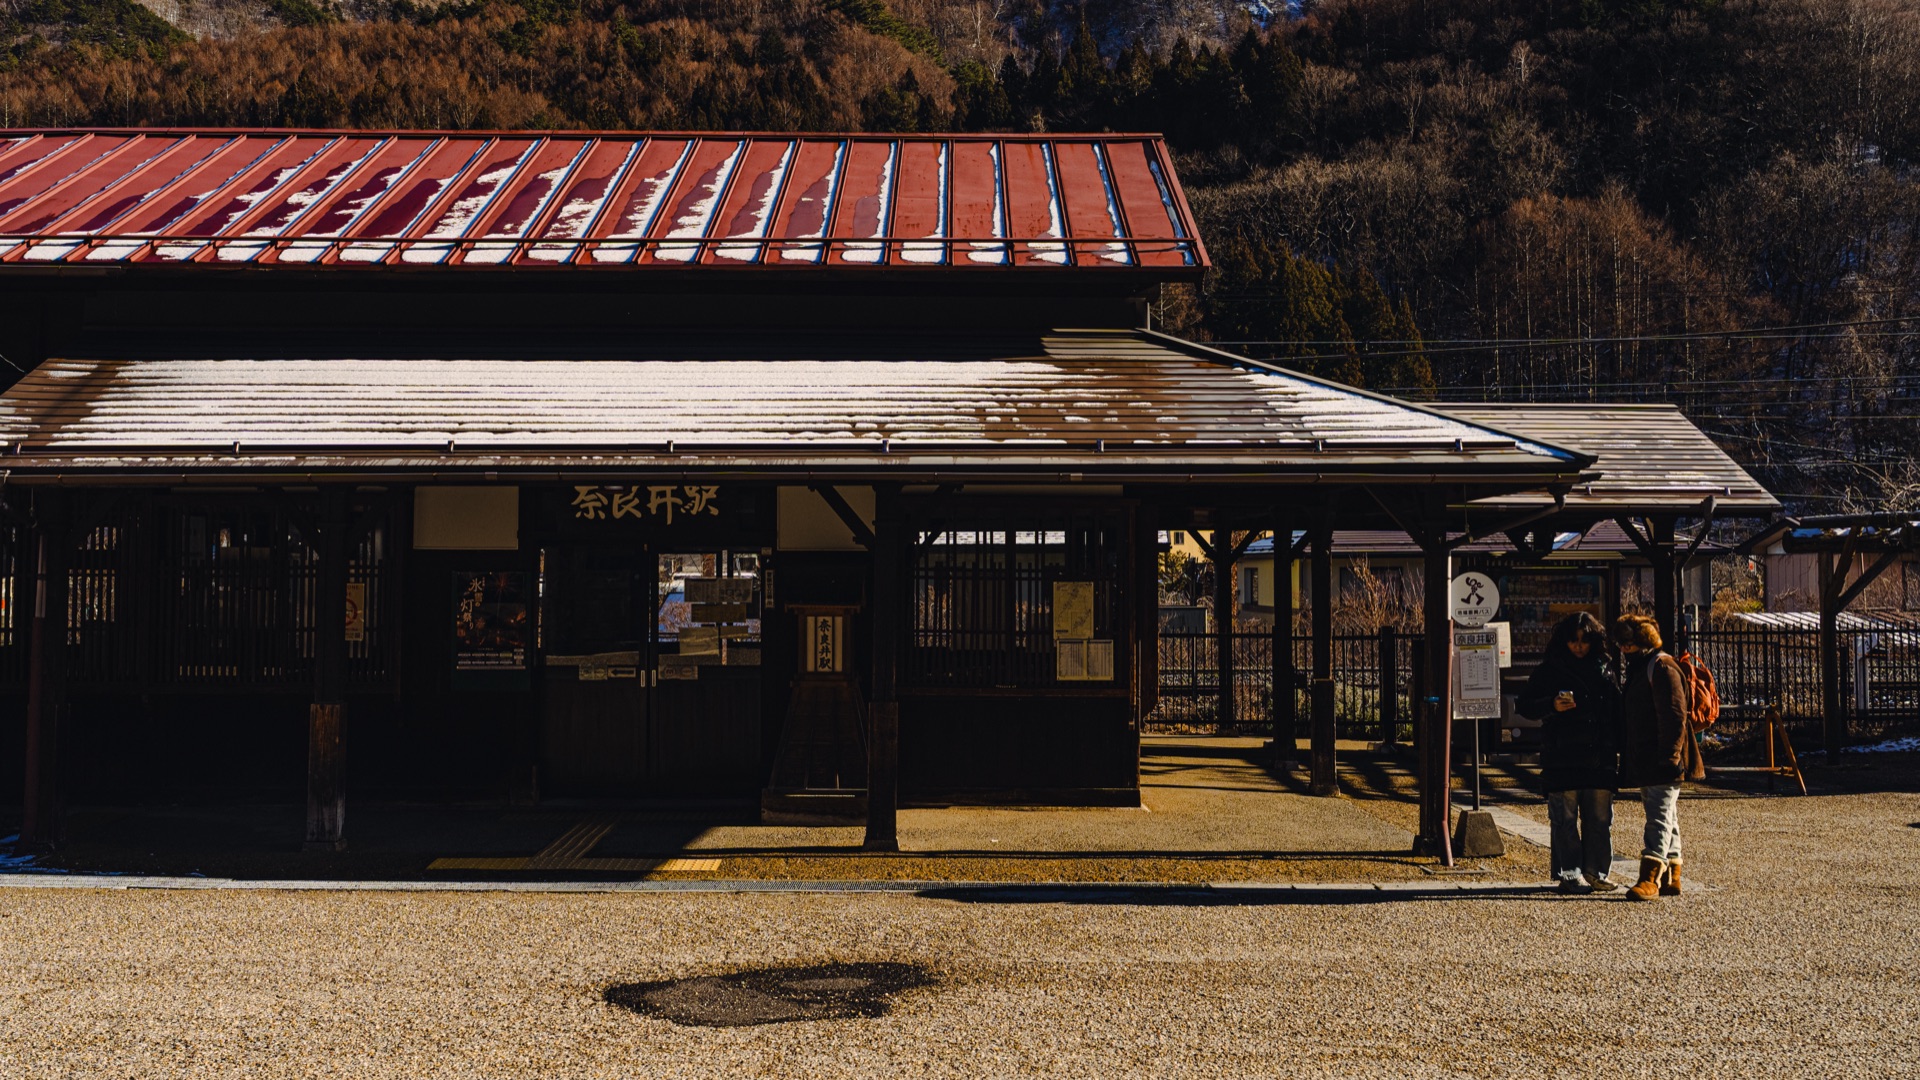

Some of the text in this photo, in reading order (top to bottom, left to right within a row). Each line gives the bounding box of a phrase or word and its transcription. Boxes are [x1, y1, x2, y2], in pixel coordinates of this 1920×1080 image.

[570, 485, 720, 526] 奈良井駅
[818, 618, 832, 670] 奈良井駅
[1457, 633, 1495, 645] 奈良井駅
